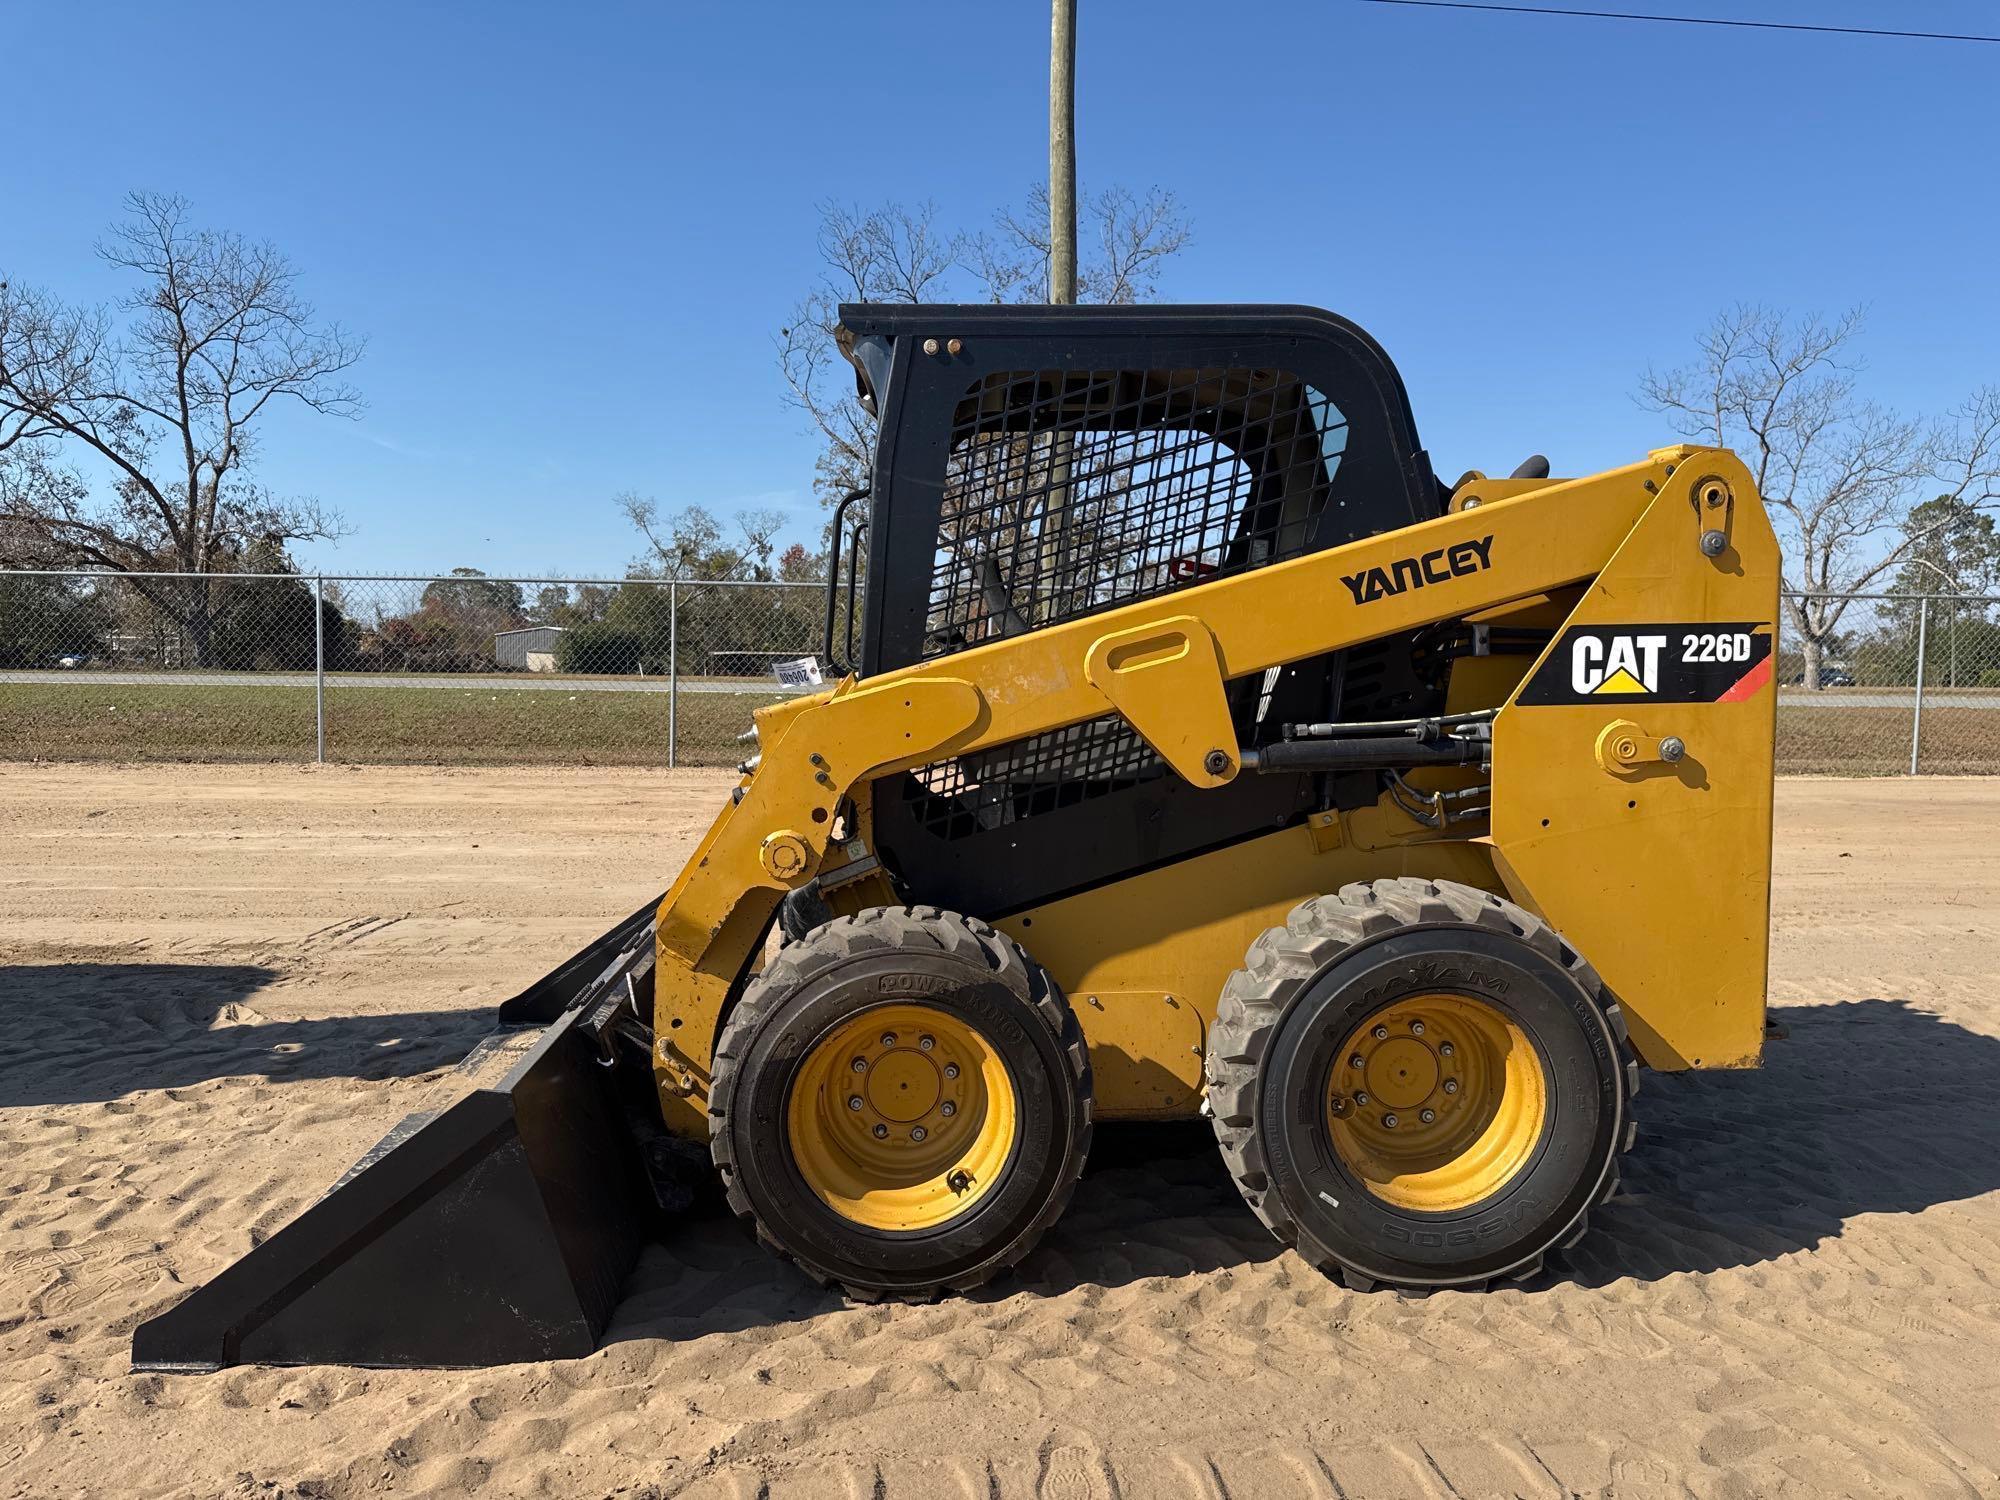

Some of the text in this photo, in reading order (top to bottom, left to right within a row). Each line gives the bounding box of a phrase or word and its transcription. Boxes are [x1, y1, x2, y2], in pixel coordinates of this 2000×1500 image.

[1339, 535, 1494, 605] YANCEY
[1571, 633, 1751, 695] CAT 226D
